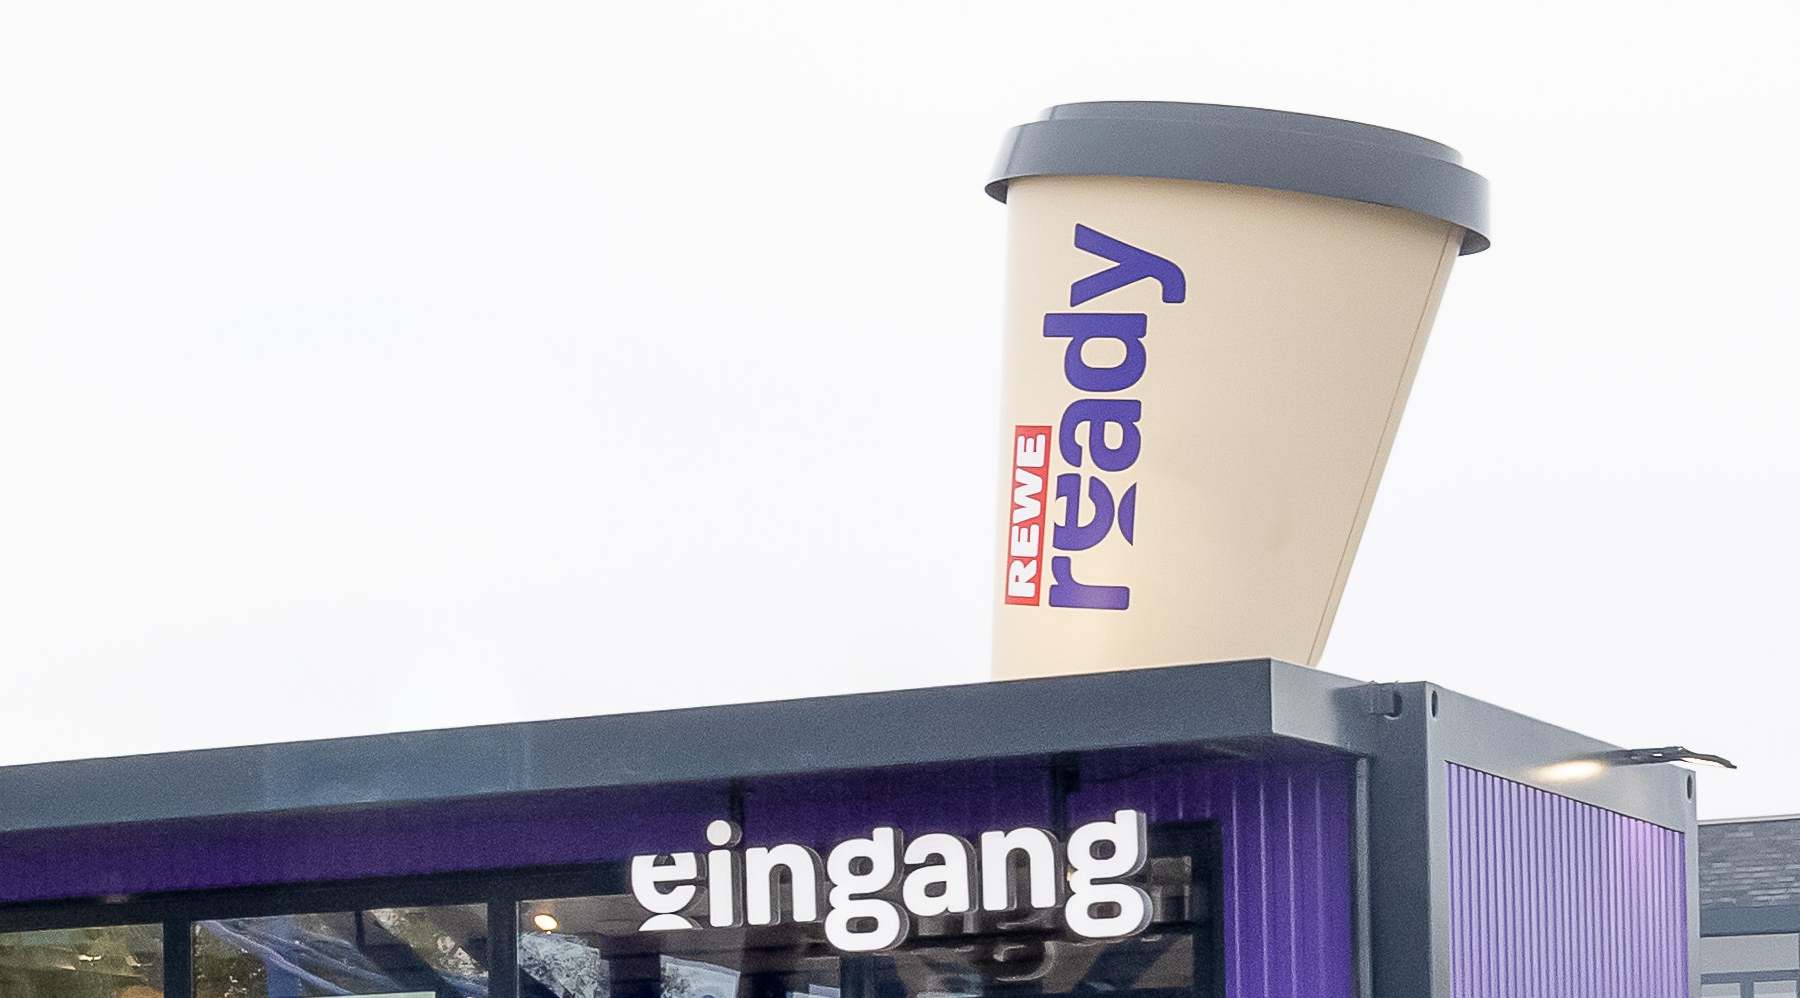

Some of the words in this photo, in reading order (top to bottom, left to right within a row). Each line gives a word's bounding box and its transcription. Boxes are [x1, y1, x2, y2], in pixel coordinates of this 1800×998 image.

[1042, 223, 1186, 610] ready
[1007, 433, 1046, 599] REWE
[631, 809, 1149, 952] eingang
